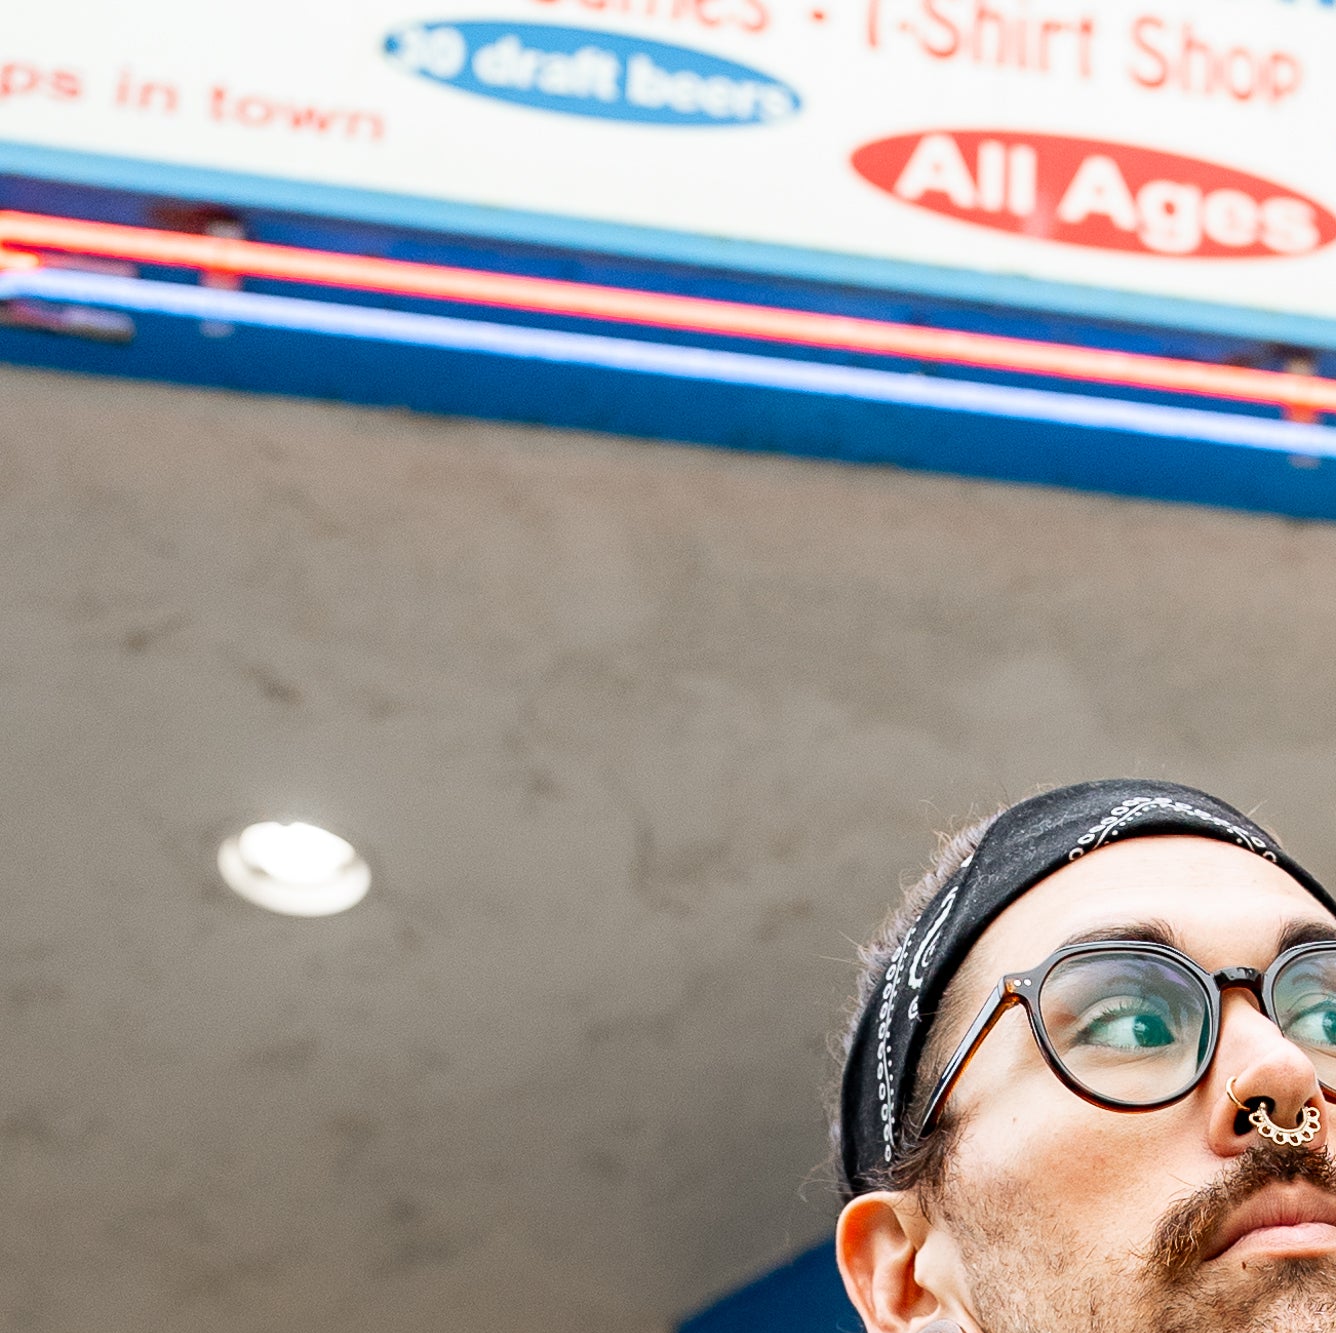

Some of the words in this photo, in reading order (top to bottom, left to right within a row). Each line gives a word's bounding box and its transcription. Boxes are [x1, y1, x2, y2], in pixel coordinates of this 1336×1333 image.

[471, 34, 621, 101] draft
[625, 53, 796, 120] beers
[1131, 17, 1302, 105] Shop
[115, 70, 180, 114] in
[209, 84, 385, 141] town
[894, 133, 1039, 216] All
[1057, 155, 1322, 256] Ages
